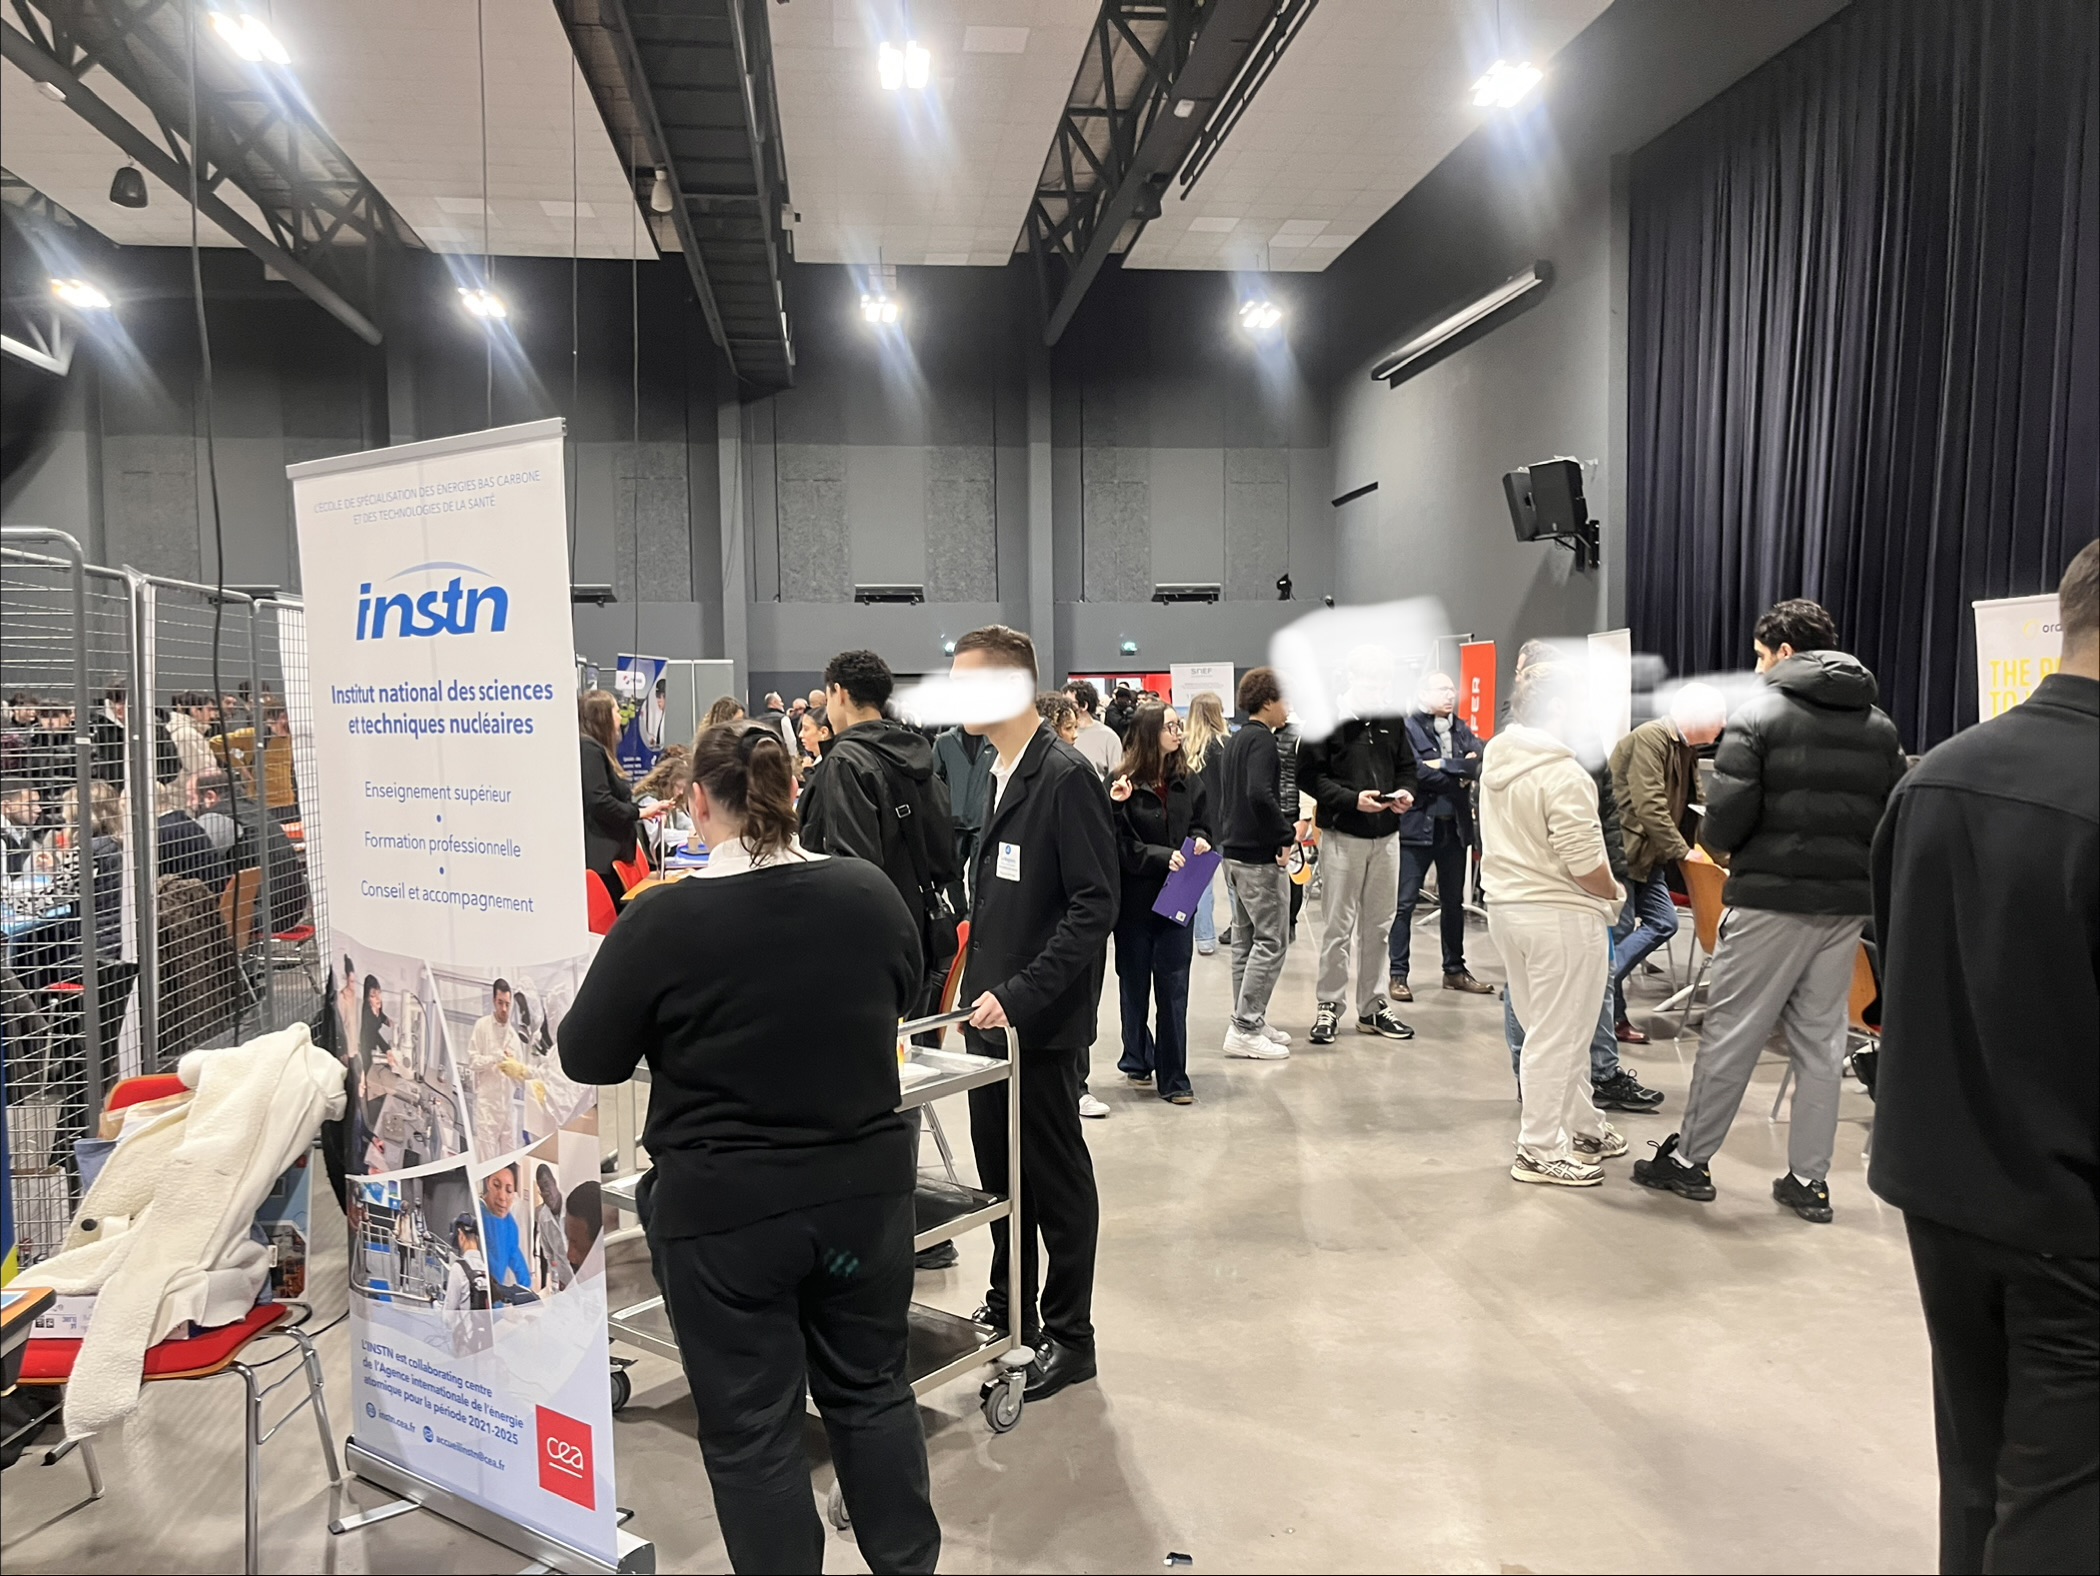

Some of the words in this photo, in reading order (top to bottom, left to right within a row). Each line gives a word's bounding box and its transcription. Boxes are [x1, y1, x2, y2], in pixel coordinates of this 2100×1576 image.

[344, 498, 357, 509] DE
[357, 489, 418, 508] SPÉCIALISATION
[419, 486, 435, 498] DES
[478, 476, 495, 489] BAS
[496, 470, 541, 487] CARBONE
[353, 514, 362, 525] ET
[363, 512, 378, 523] DES
[379, 503, 441, 521] TECHNOLOGIES
[443, 502, 454, 513] DE
[455, 500, 467, 512] LA
[468, 493, 496, 510] SANTÉ
[356, 576, 509, 641] instn
[1989, 659, 2032, 688] THE
[331, 683, 375, 705] Institut
[379, 679, 443, 703] national
[447, 679, 476, 702] des
[479, 678, 554, 702] sciences
[1471, 677, 1480, 738] FER
[348, 715, 360, 735] et
[361, 712, 445, 740] techniques
[450, 712, 534, 735] nucléaires
[365, 781, 452, 805] Enseignement
[454, 783, 512, 806] supérieur
[364, 831, 426, 850] Formation
[429, 835, 522, 858] professionnelle
[361, 880, 405, 900] Conseil
[408, 886, 420, 901] et
[422, 887, 534, 913] accompagnement
[396, 1352, 408, 1365] est
[409, 1358, 463, 1389] collaborating
[465, 1381, 493, 1398] centre
[363, 1357, 373, 1370] de
[374, 1360, 410, 1383] l'Agence
[411, 1374, 469, 1407] internationale
[471, 1400, 482, 1413] de
[484, 1404, 524, 1429] l'énergie
[364, 1376, 402, 1397] atomique
[404, 1391, 423, 1405] pour
[424, 1396, 432, 1409] la
[434, 1403, 467, 1424] période
[468, 1415, 518, 1445] 2021-2025
[546, 1436, 584, 1471] cea
